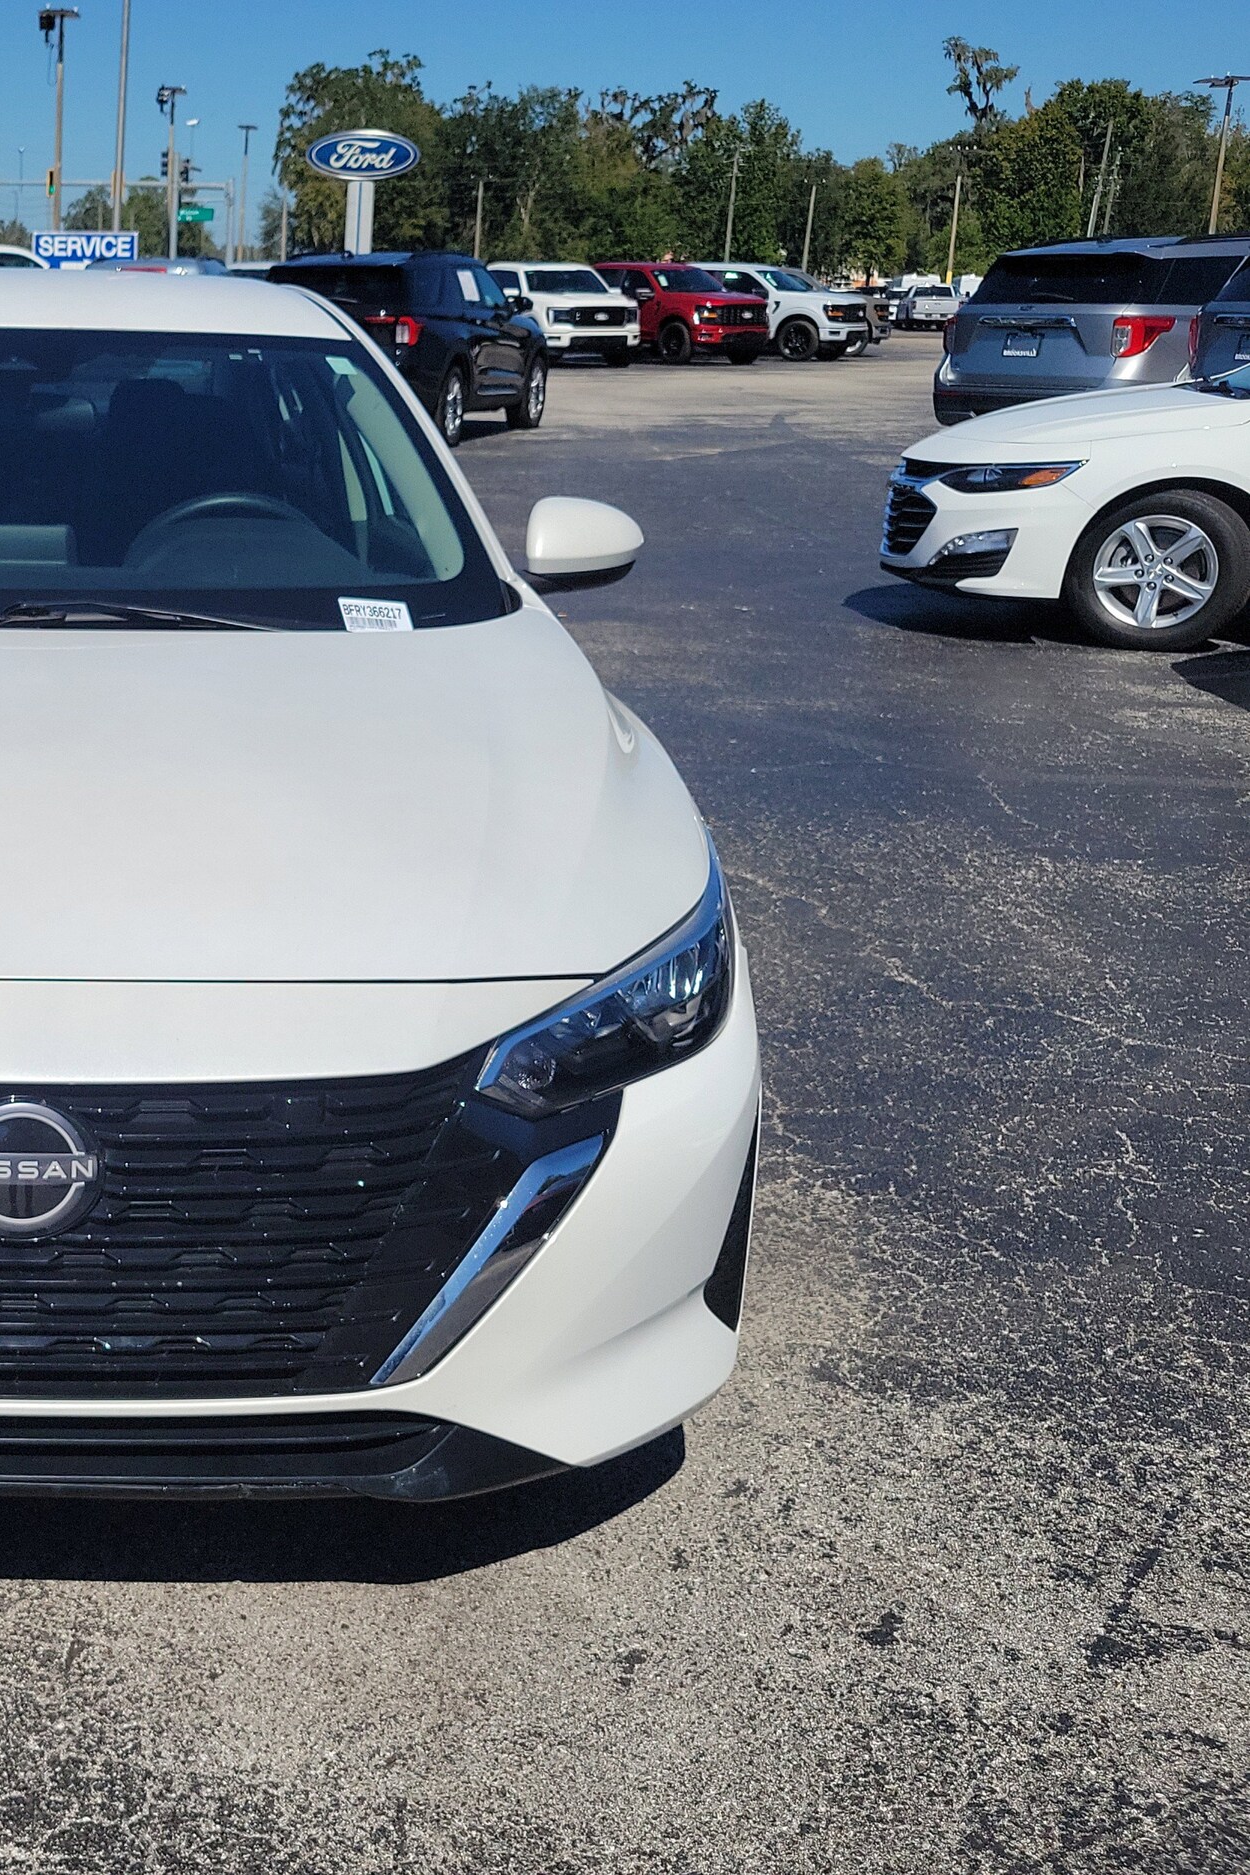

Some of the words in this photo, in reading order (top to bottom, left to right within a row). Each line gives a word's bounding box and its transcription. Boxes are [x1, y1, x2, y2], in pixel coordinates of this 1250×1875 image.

[329, 139, 397, 169] Ford
[38, 236, 132, 258] SERVICE
[342, 604, 402, 620] BFRY366217
